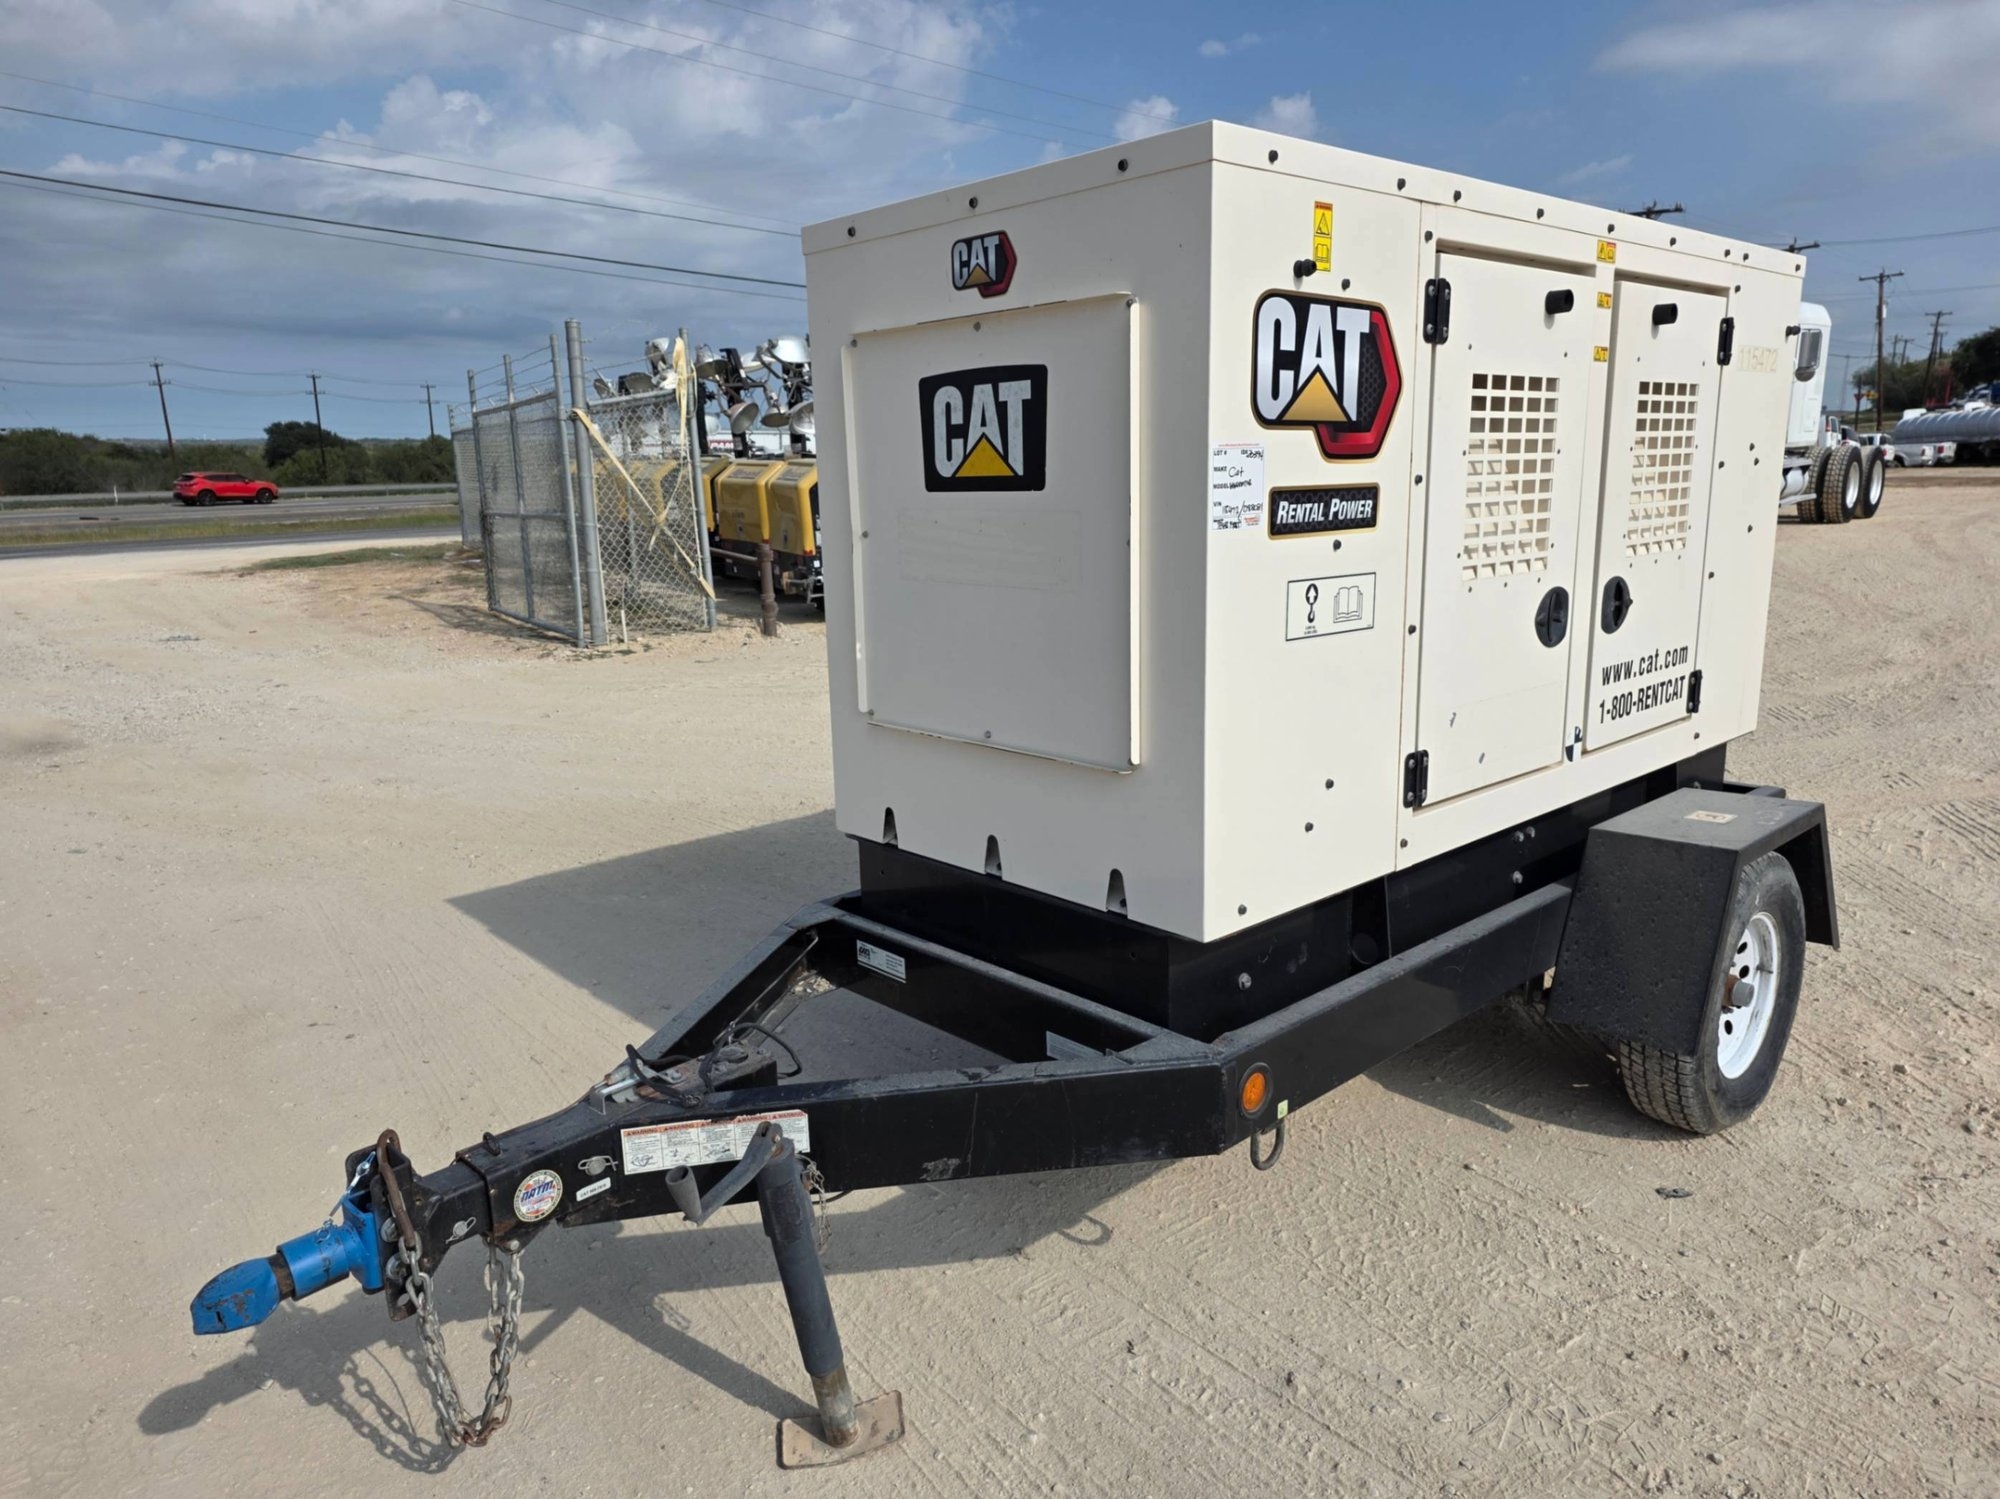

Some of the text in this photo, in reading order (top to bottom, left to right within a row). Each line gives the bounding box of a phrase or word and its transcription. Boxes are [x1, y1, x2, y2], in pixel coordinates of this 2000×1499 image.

[953, 234, 1000, 288] CAT
[1256, 296, 1371, 422] CAT
[932, 379, 1032, 478] CAT
[1228, 466, 1244, 478] Cat
[1276, 499, 1325, 525] RENTAL
[1328, 497, 1374, 521] POWER
[1602, 645, 1689, 686] www.cat.com
[1599, 675, 1686, 724] 1-800-RENTCAT
